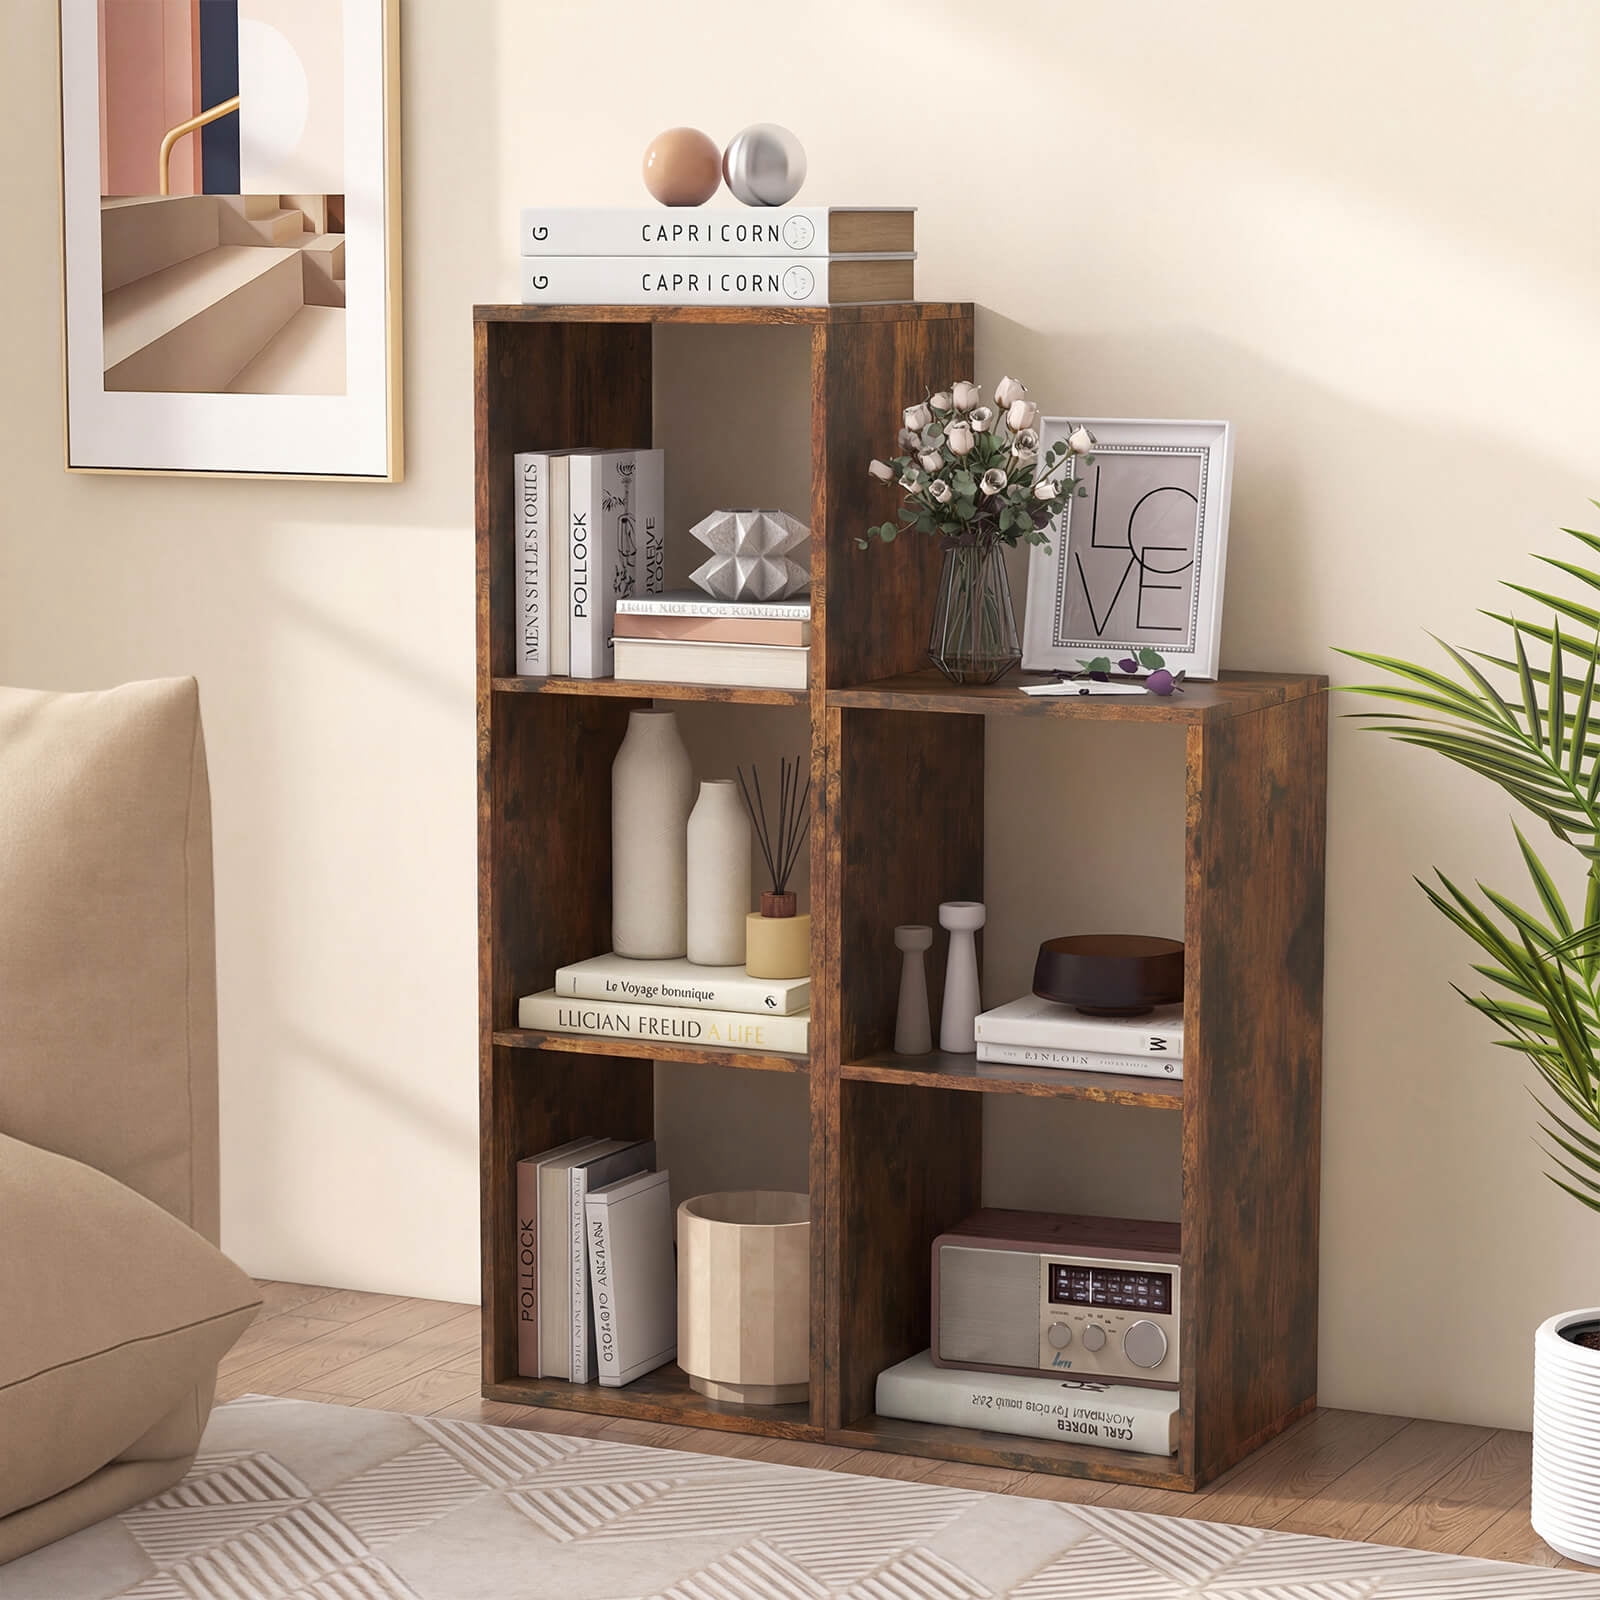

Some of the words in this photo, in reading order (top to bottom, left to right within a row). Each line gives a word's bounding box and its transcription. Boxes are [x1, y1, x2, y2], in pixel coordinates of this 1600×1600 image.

[642, 223, 781, 243] CAPRICORN
[642, 273, 781, 293] CAPRICORN
[573, 511, 588, 618] POLLOCK
[605, 979, 618, 992] Le
[621, 980, 659, 998] Voyage
[707, 1024, 722, 1041] A
[727, 1026, 766, 1045] LIFE
[520, 1218, 535, 1322] POLLOCK
[1102, 1425, 1134, 1441] CARL
